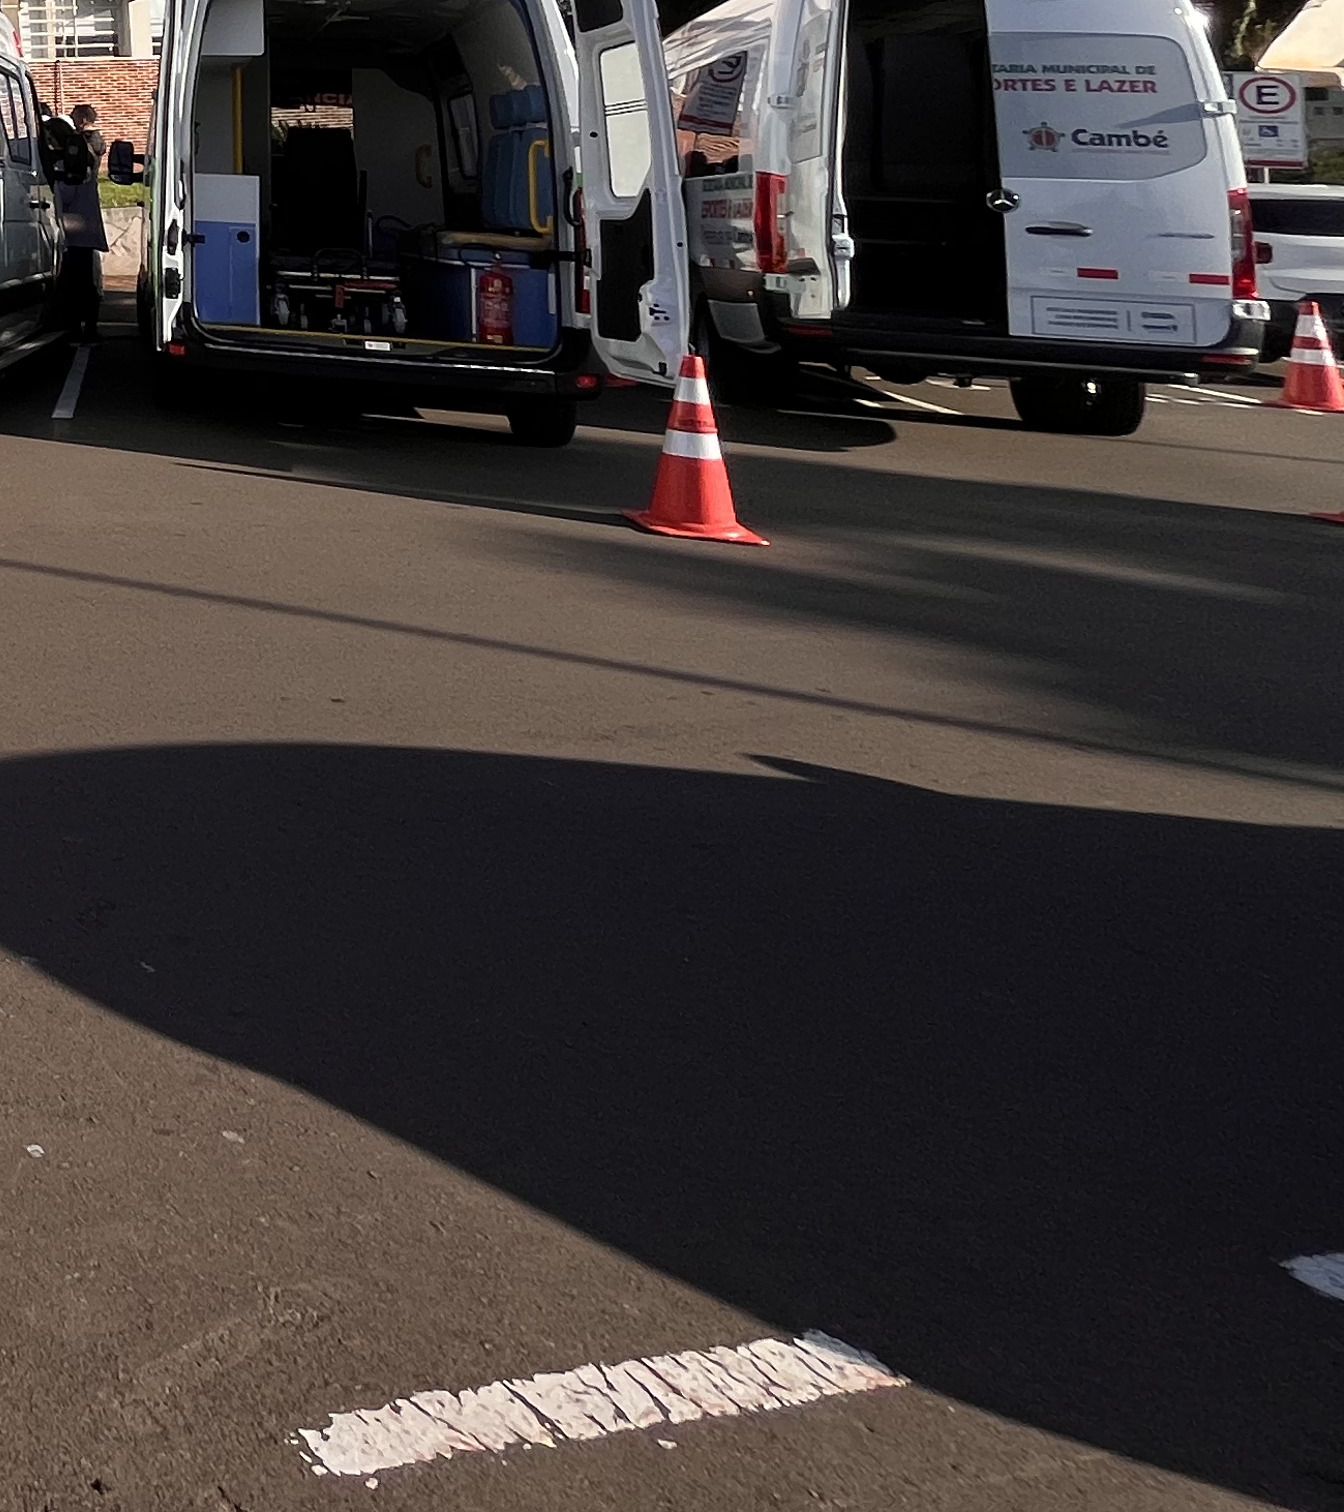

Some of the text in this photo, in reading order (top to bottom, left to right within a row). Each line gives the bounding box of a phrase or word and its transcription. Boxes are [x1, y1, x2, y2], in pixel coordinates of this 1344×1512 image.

[1042, 64, 1130, 75] MUNICIPAL
[1135, 65, 1156, 75] DE
[1065, 78, 1077, 92] E
[1085, 79, 1157, 93] LAZER
[1256, 85, 1279, 105] E
[1071, 128, 1169, 148] Cambé
